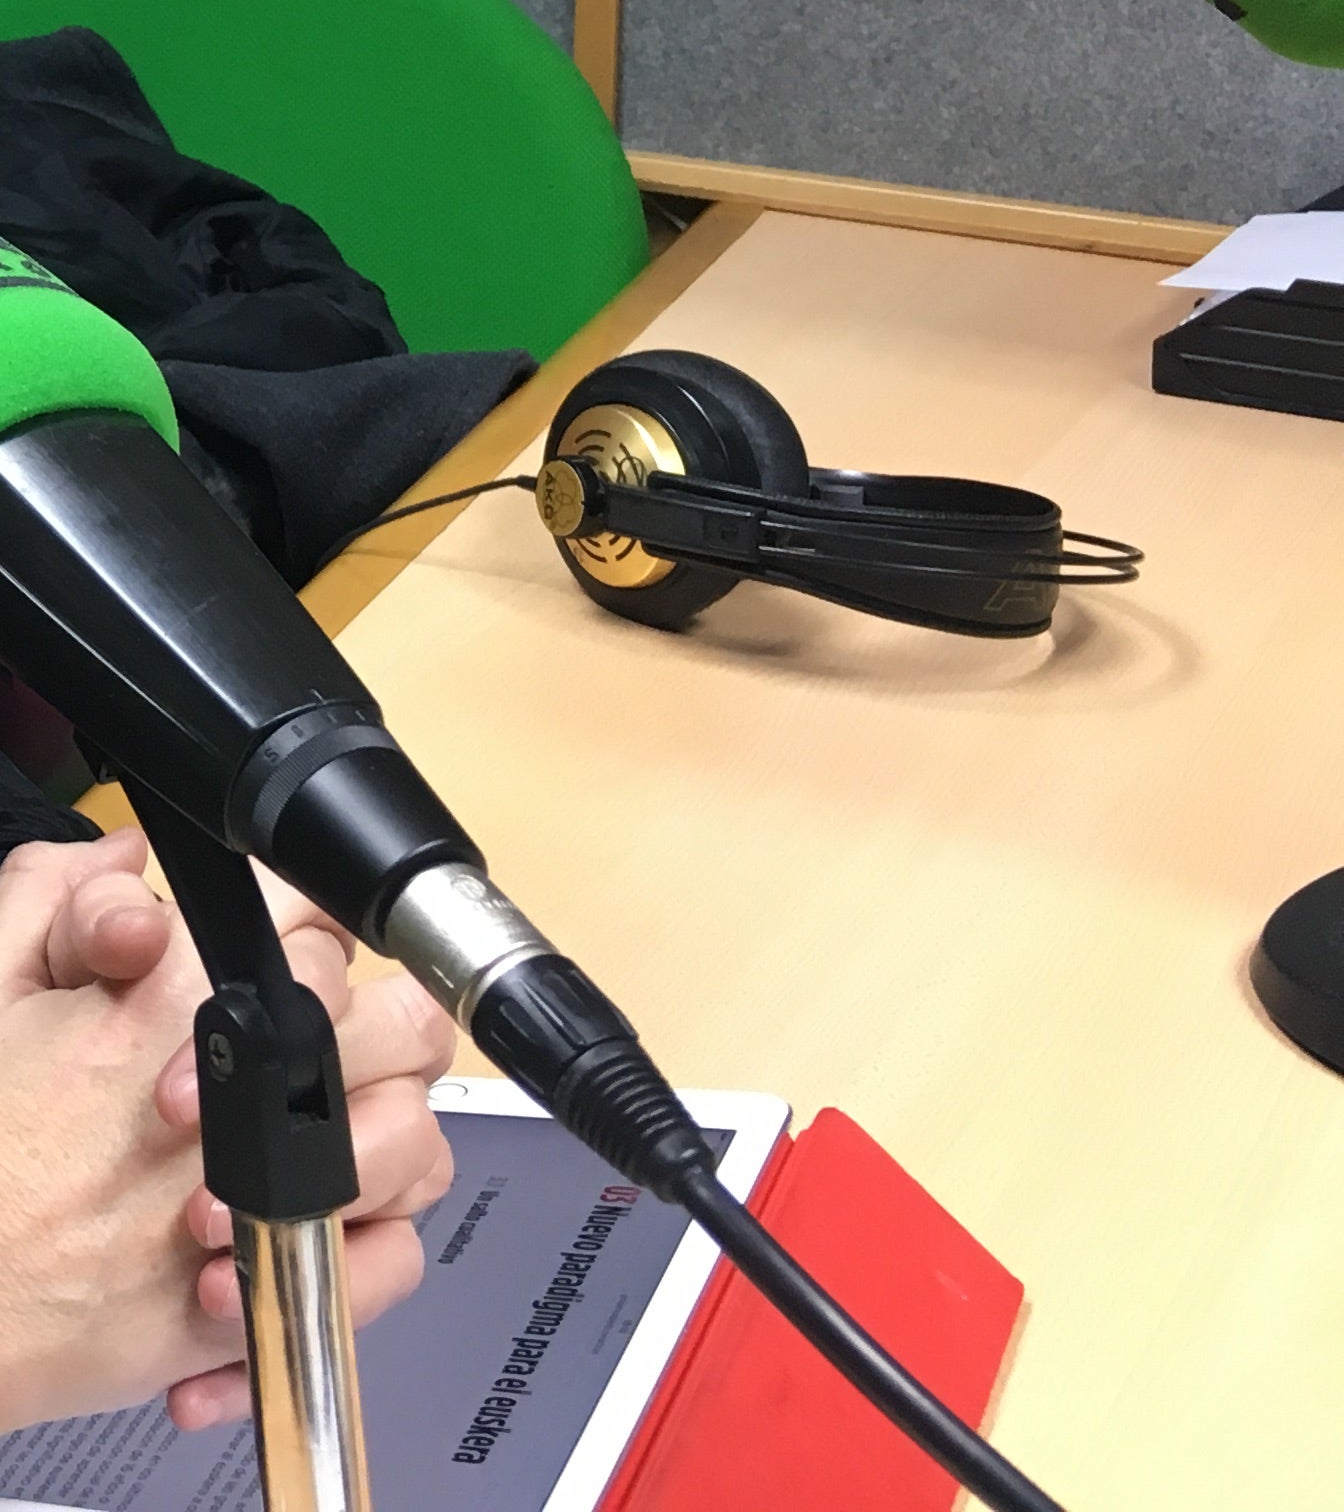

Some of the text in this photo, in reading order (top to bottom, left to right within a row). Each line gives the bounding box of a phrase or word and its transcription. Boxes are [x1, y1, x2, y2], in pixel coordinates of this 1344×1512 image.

[464, 1202, 488, 1221] salto
[600, 1186, 640, 1204] 03
[438, 1223, 475, 1264] cualitativo
[573, 1205, 630, 1250] Nuevo
[524, 1253, 595, 1335] paradigma
[503, 1338, 549, 1375] para
[492, 1378, 531, 1395] el
[452, 1397, 516, 1463] euskera
